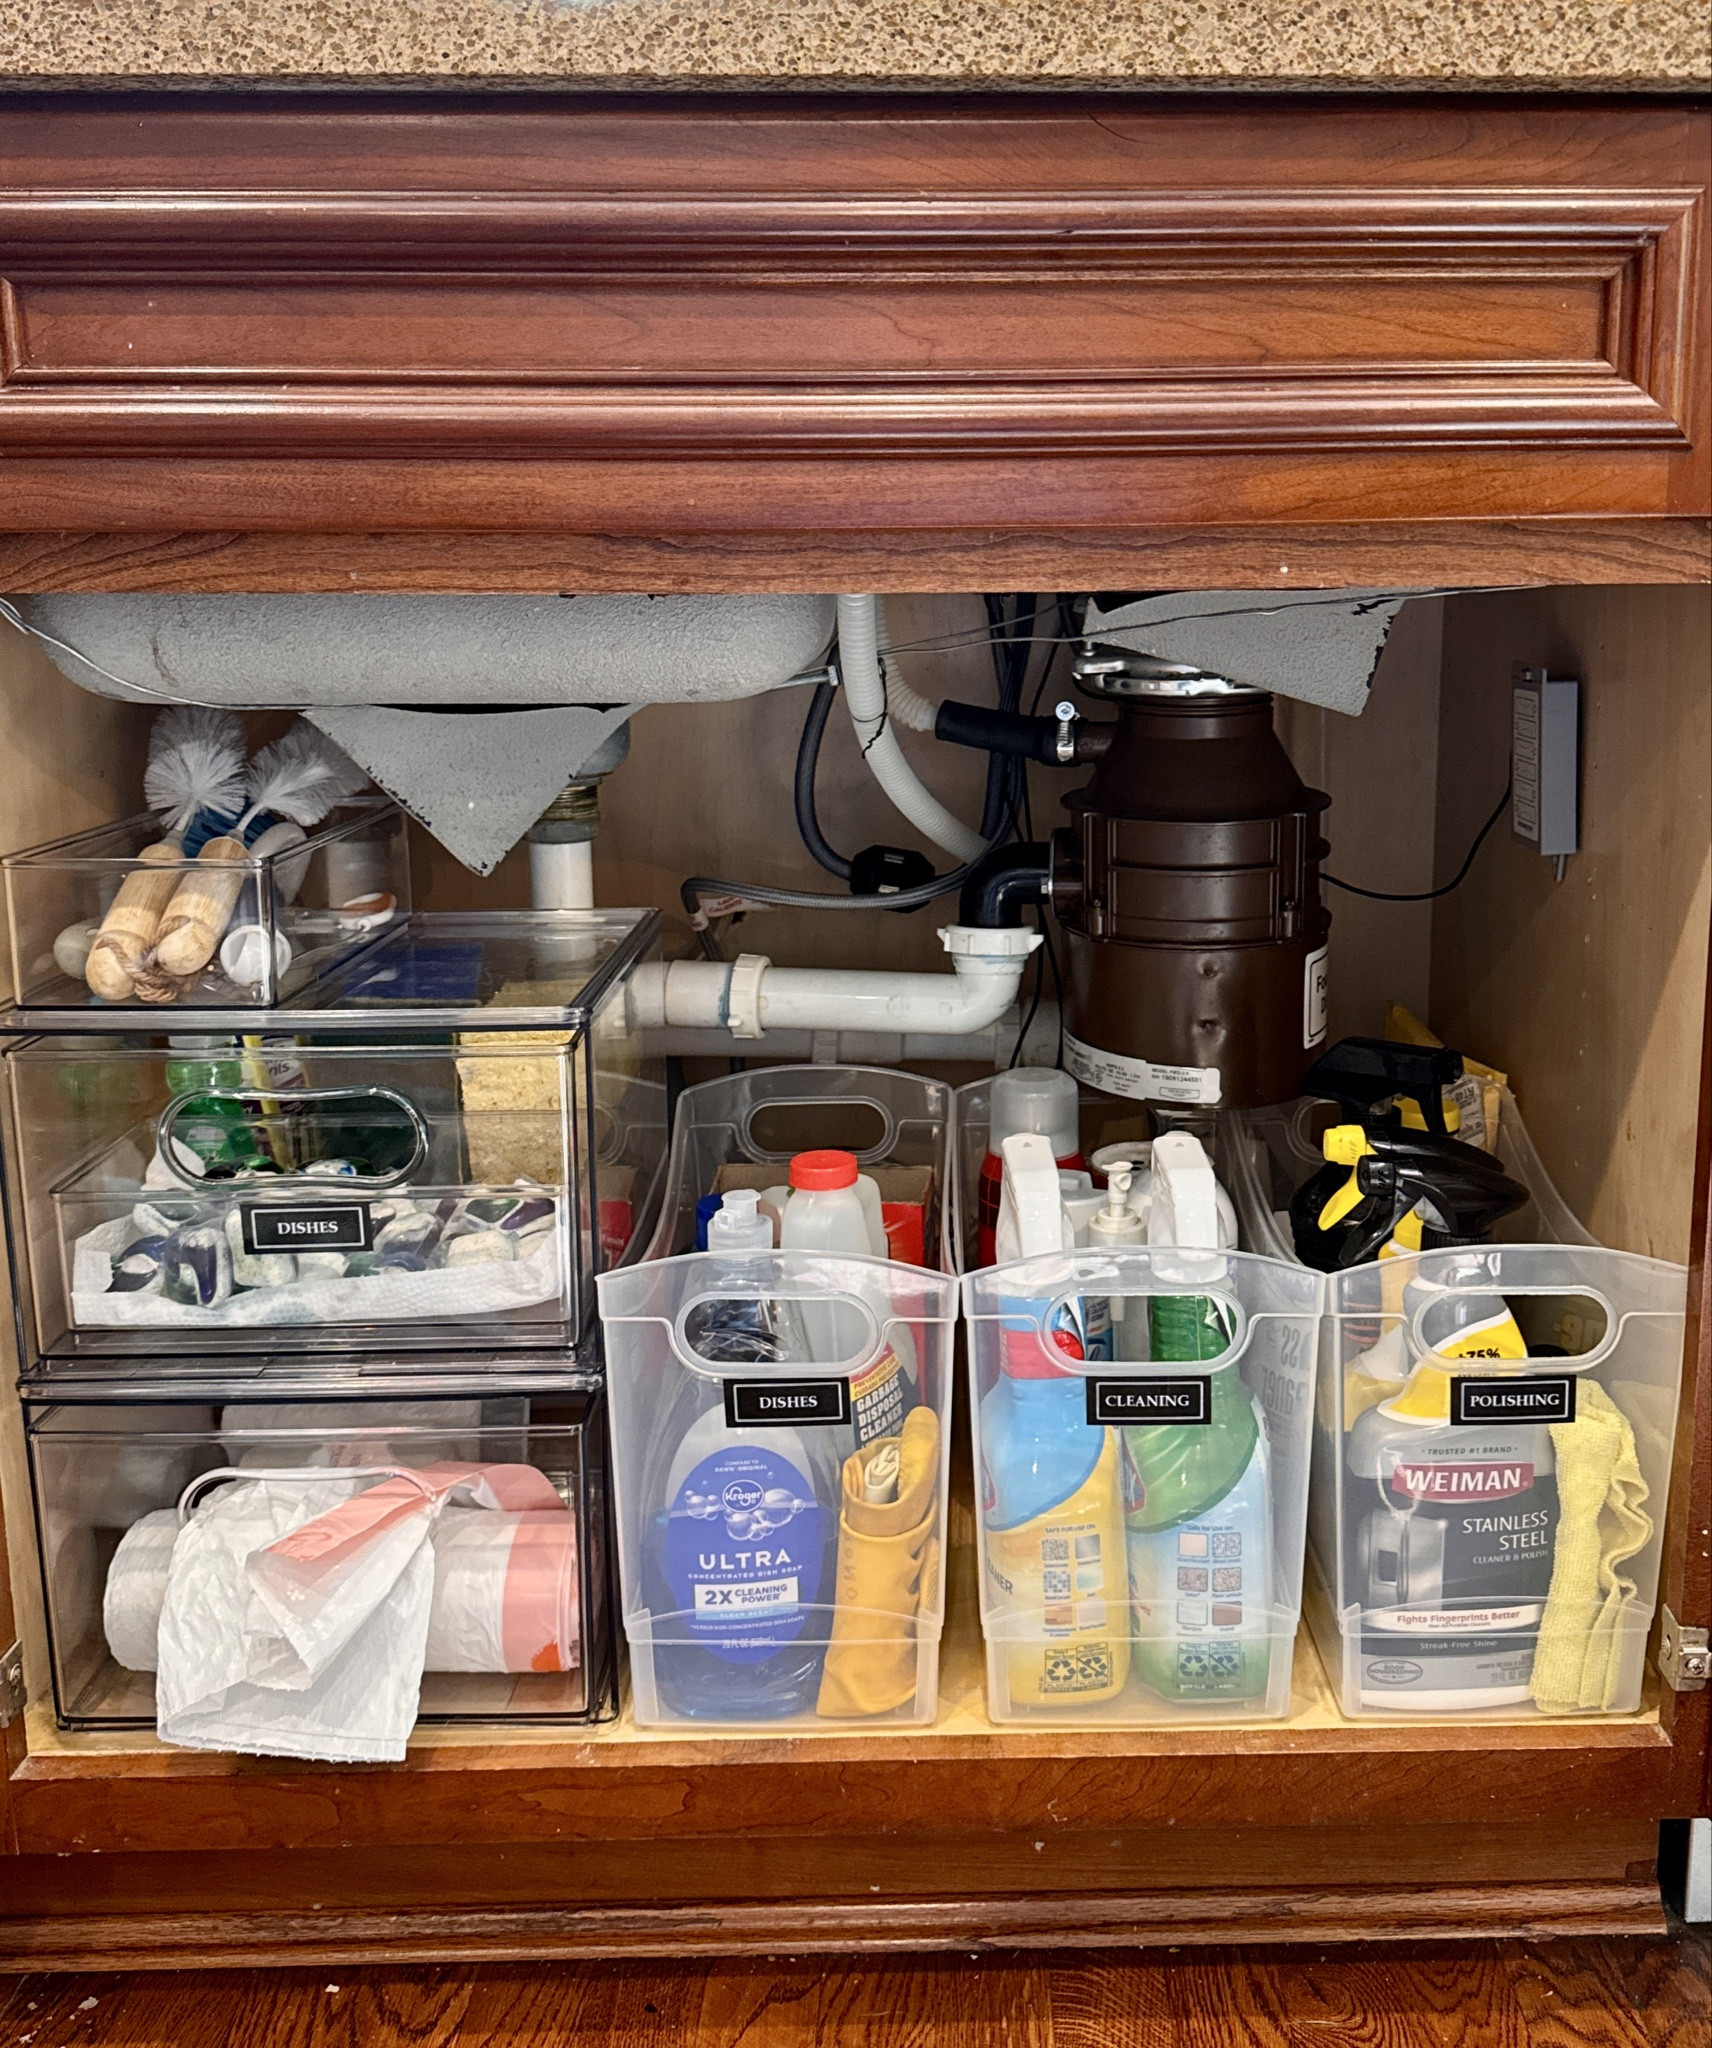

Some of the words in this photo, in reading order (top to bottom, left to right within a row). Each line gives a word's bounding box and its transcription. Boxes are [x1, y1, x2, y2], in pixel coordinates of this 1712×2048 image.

[277, 1221, 339, 1235] DISHES
[759, 1395, 818, 1409] DISHES
[856, 1373, 900, 1413] GARBAGE
[1105, 1394, 1190, 1407] CLEANING
[1470, 1393, 1560, 1408] POLISHING
[858, 1386, 903, 1428] DISPOSAL
[860, 1401, 903, 1442] CLEANER
[1427, 1448, 1466, 1456] TRUSTED
[1482, 1446, 1513, 1454] BRAND
[1405, 1467, 1522, 1493] WEIMAN
[725, 1486, 762, 1507] Kroger
[1462, 1510, 1549, 1534] STAINLESS
[1499, 1530, 1549, 1551] STEEL
[699, 1548, 792, 1570] ULTRA
[1472, 1555, 1512, 1565] CLEANER
[1520, 1549, 1549, 1560] POLISH
[687, 1572, 755, 1580] CONCENTRATED
[757, 1569, 778, 1577] DISH
[781, 1564, 803, 1574] SOAP
[704, 1589, 734, 1605] 2X
[734, 1583, 788, 1598] CLEANING
[1397, 1615, 1428, 1625] Fights
[1430, 1612, 1489, 1625] Fingerprints
[1491, 1610, 1521, 1621] Better
[1473, 1639, 1498, 1648] Shine
